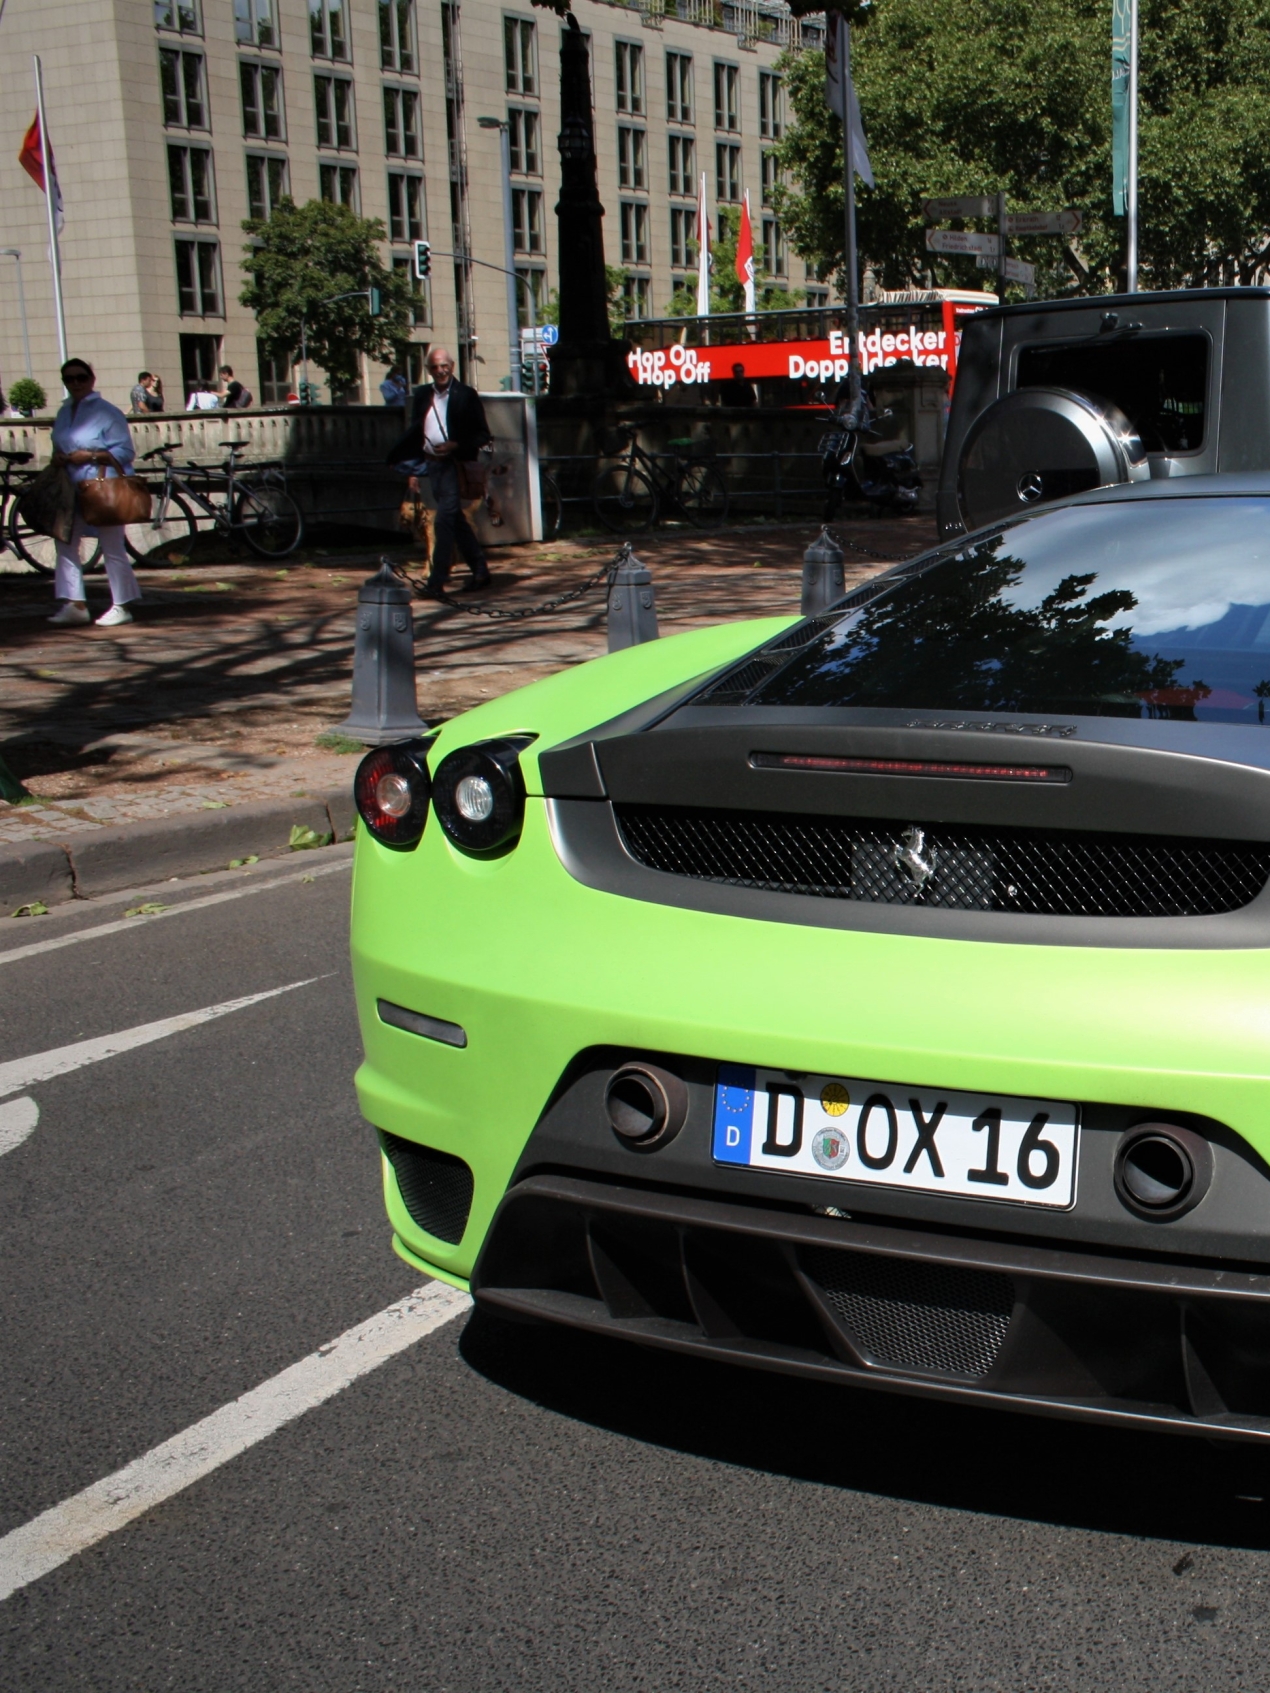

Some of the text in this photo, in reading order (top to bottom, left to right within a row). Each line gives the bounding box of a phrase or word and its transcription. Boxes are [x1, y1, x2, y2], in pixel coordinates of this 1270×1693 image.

[949, 234, 968, 242] Hilden
[628, 344, 697, 371] Hop On
[788, 348, 949, 383] Doppldeker
[638, 361, 711, 389] Hop Off
[726, 1126, 741, 1147] D
[761, 1082, 805, 1157] D
[856, 1093, 948, 1178] OX
[967, 1107, 1060, 1190] 16
